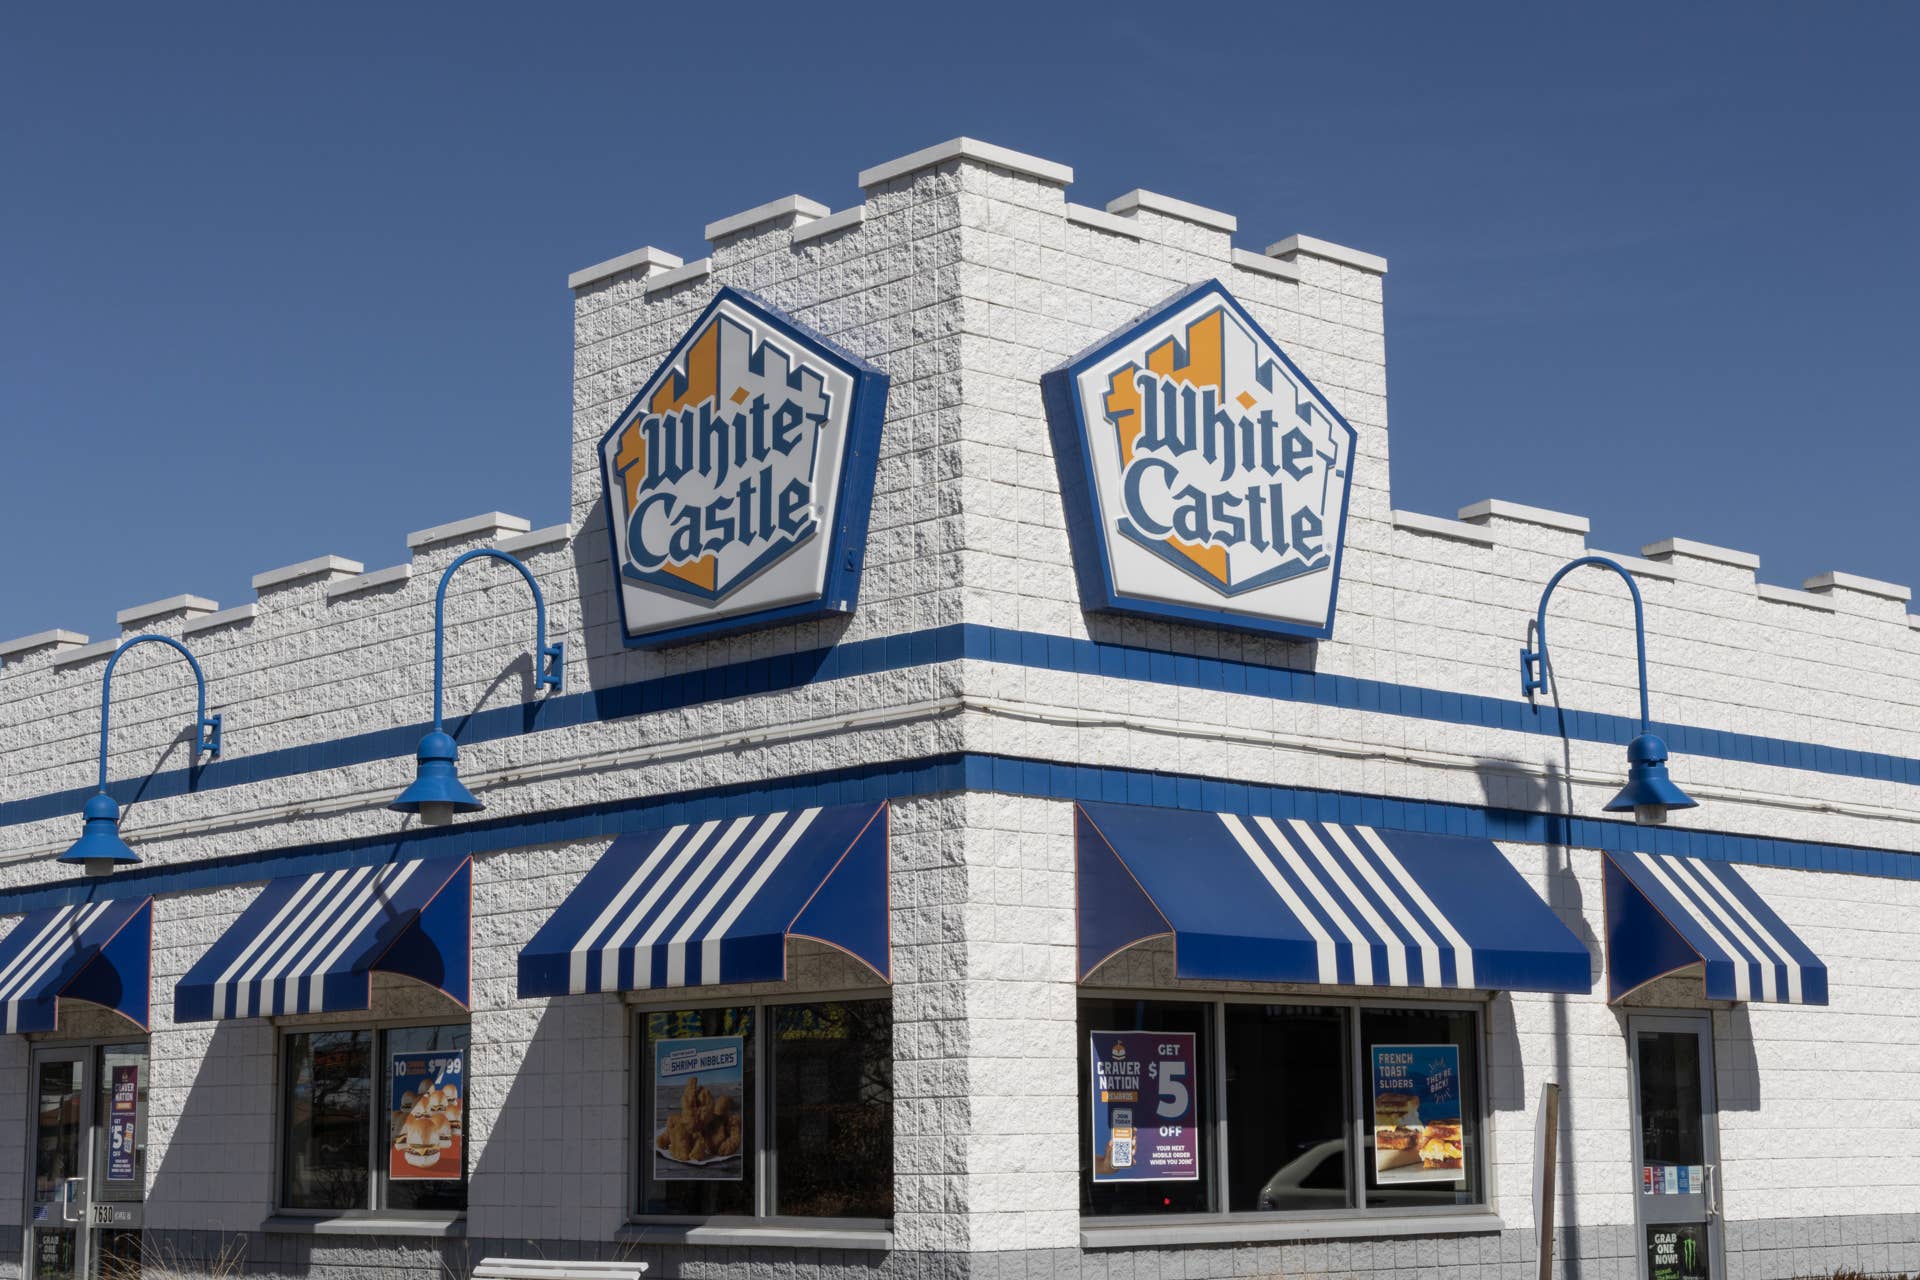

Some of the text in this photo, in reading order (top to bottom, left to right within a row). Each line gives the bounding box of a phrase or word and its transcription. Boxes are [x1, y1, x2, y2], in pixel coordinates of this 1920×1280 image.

[1136, 374, 1314, 481] White
[640, 393, 804, 494] White
[1124, 457, 1324, 560] Castle
[628, 465, 812, 568] Castle
[1157, 1044, 1181, 1056] GET
[671, 1058, 698, 1073] SHRIMP
[700, 1053, 735, 1068] NIBBLERS
[1378, 1053, 1413, 1064] FRENCH
[394, 1060, 407, 1077] 10
[1097, 1061, 1141, 1075] CRAVER
[1379, 1065, 1408, 1077] TOAST
[1100, 1076, 1140, 1090] NATION
[1379, 1079, 1414, 1089] SLIDERS
[1159, 1126, 1183, 1137] OFF
[94, 1206, 113, 1223] 7630
[1654, 1233, 1678, 1244] GRAB
[1657, 1244, 1675, 1254] ONE
[1655, 1254, 1678, 1265] NOW!
